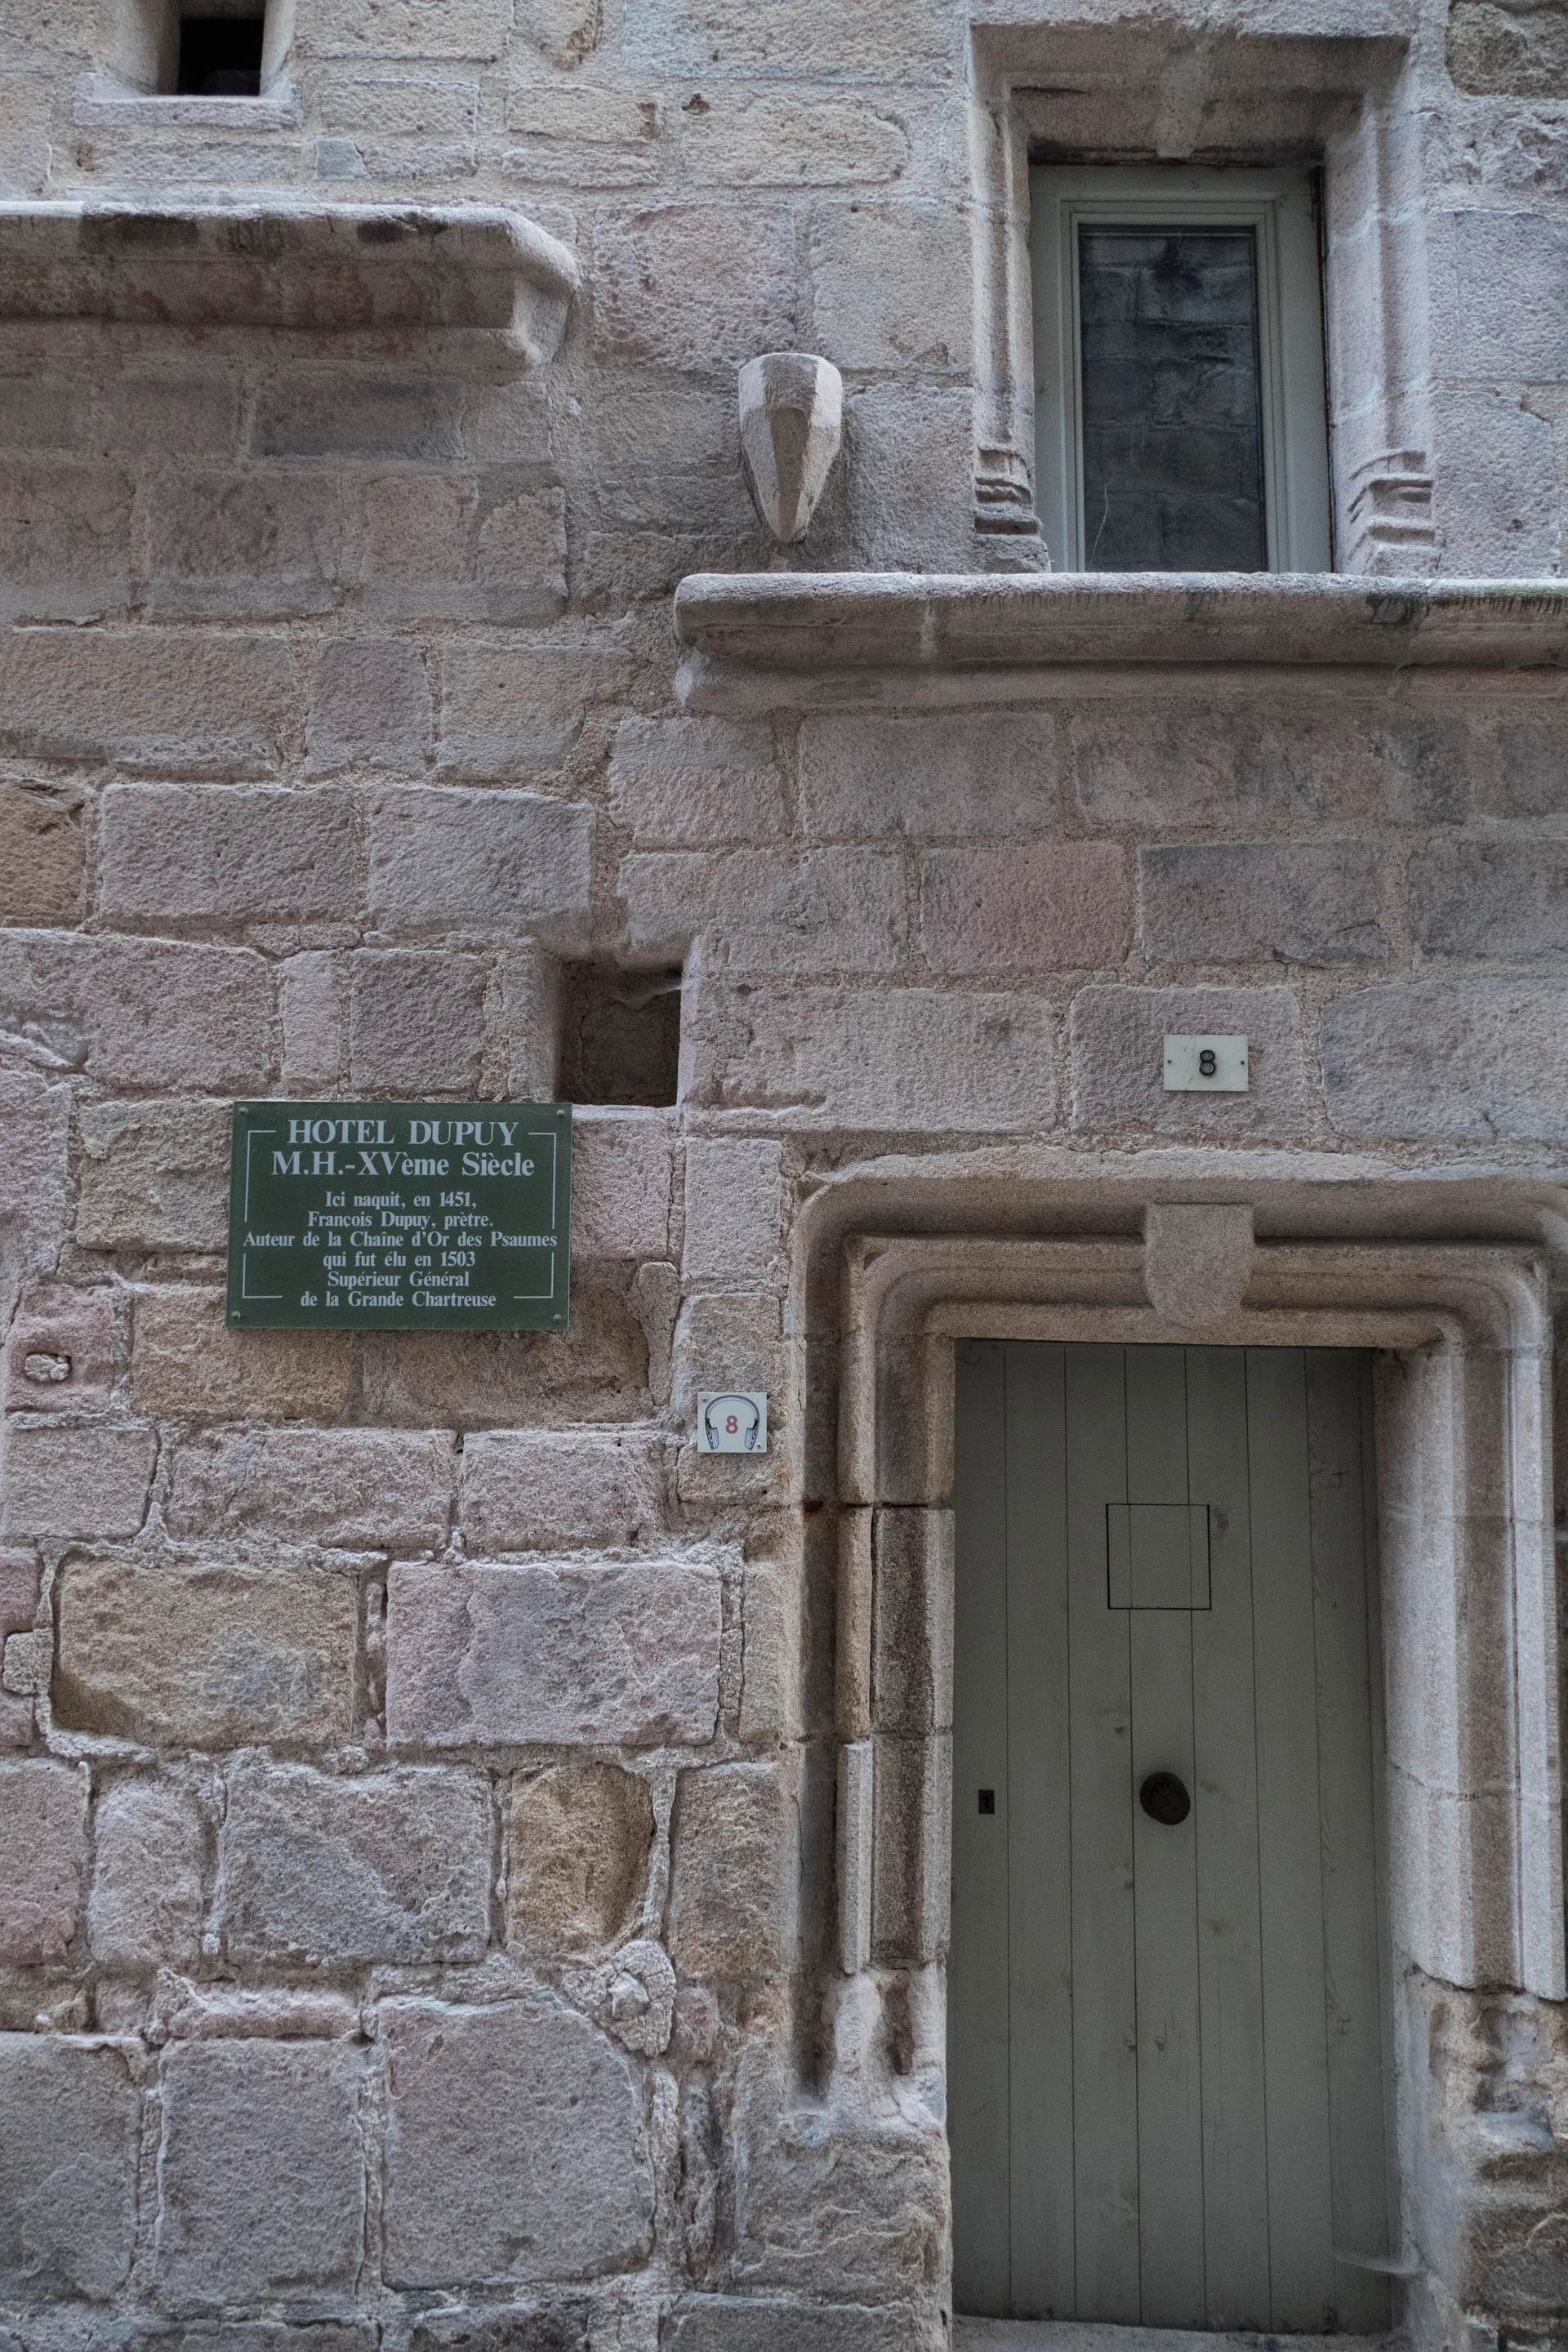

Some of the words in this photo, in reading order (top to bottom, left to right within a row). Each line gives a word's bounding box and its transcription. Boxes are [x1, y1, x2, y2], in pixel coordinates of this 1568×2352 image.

[1198, 1049, 1217, 1076] 8
[287, 1119, 395, 1144] HOTEL
[407, 1120, 519, 1146] DUPUY
[461, 1152, 535, 1177] Siècle
[325, 1191, 345, 1207] Ici
[354, 1191, 406, 1210] naquit,
[413, 1195, 430, 1207] en
[439, 1191, 477, 1209] 1451,
[307, 1210, 372, 1228] François
[381, 1210, 436, 1231] Dupuy,
[243, 1231, 296, 1247] Auteur
[302, 1231, 320, 1247] de
[327, 1231, 342, 1247] la
[350, 1231, 404, 1247] Chaîne
[457, 1231, 483, 1247] des
[490, 1231, 558, 1247] Psaumes
[323, 1250, 346, 1270] qui
[354, 1250, 376, 1267] fut
[384, 1250, 407, 1267] élu
[414, 1255, 432, 1267] en
[440, 1250, 476, 1267] 1503
[327, 1271, 402, 1290] Supérieur
[409, 1271, 470, 1287] Général
[300, 1290, 318, 1307] de
[325, 1290, 340, 1307] la
[348, 1290, 404, 1307] Grande
[412, 1290, 497, 1307] Chartreuse
[725, 1414, 738, 1435] 8
